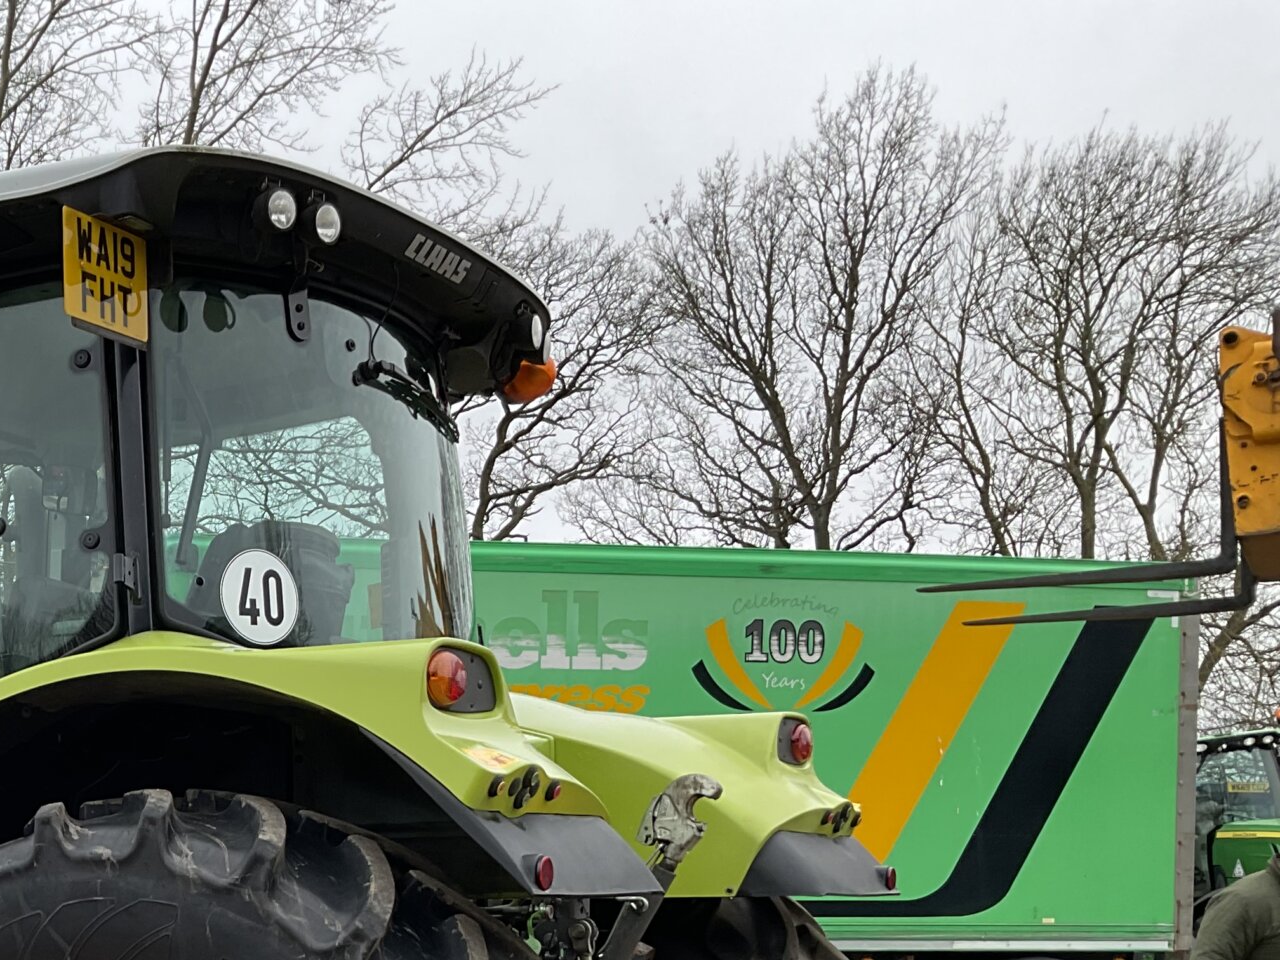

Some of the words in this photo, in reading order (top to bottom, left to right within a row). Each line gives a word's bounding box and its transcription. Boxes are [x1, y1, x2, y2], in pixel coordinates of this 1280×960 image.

[76, 216, 135, 279] WA19
[404, 233, 472, 284] CLAAS
[81, 270, 132, 328] FHT
[238, 567, 284, 626] 40
[744, 618, 825, 664] 100
[762, 672, 805, 690] Years
